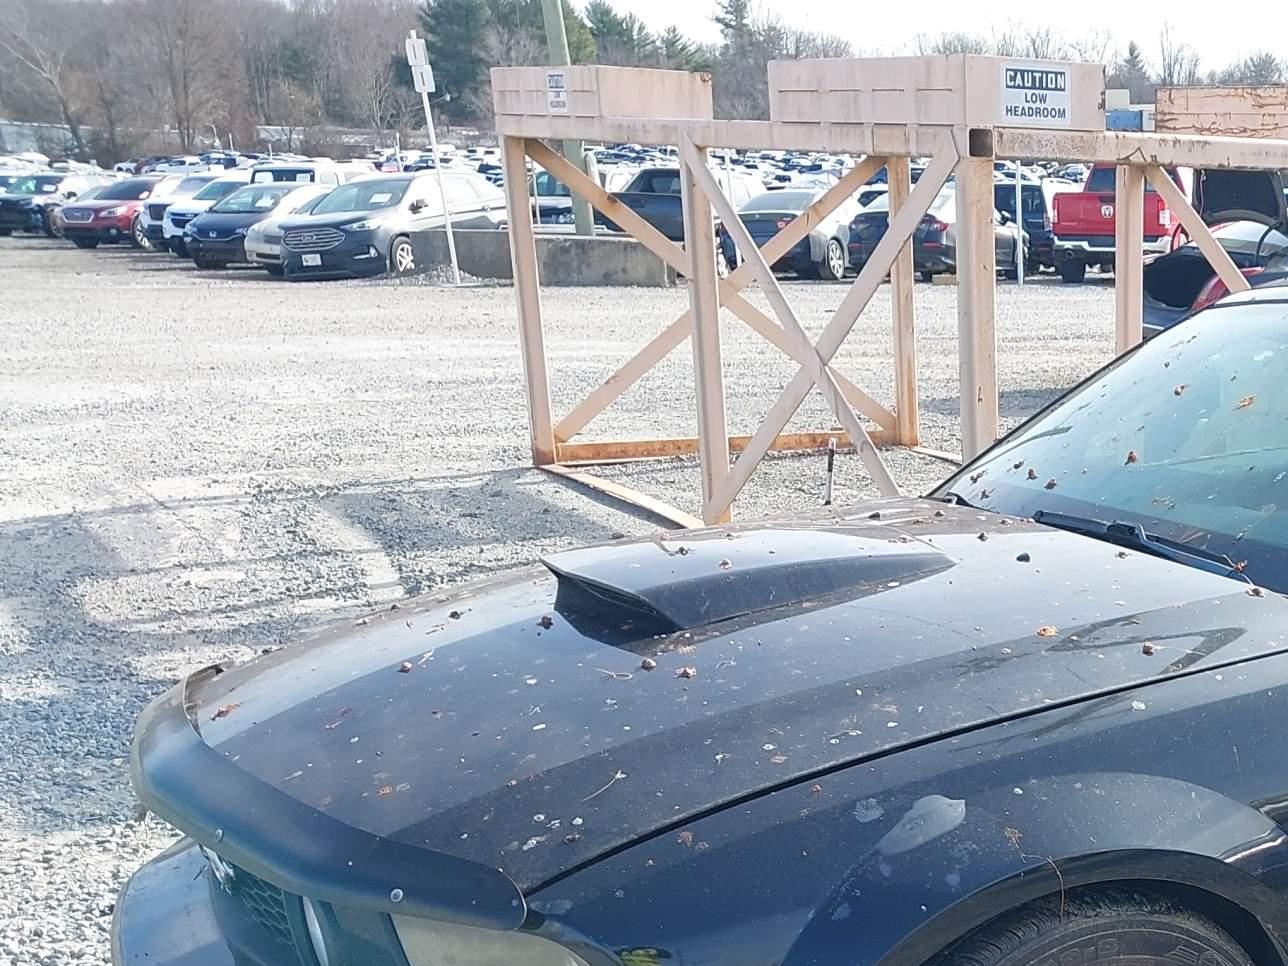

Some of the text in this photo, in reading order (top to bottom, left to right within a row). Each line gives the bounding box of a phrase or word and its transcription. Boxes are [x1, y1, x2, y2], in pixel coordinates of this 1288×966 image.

[1006, 70, 1065, 90] CAUTION
[1024, 92, 1047, 105] LOW
[1005, 104, 1066, 119] HEADROOM
